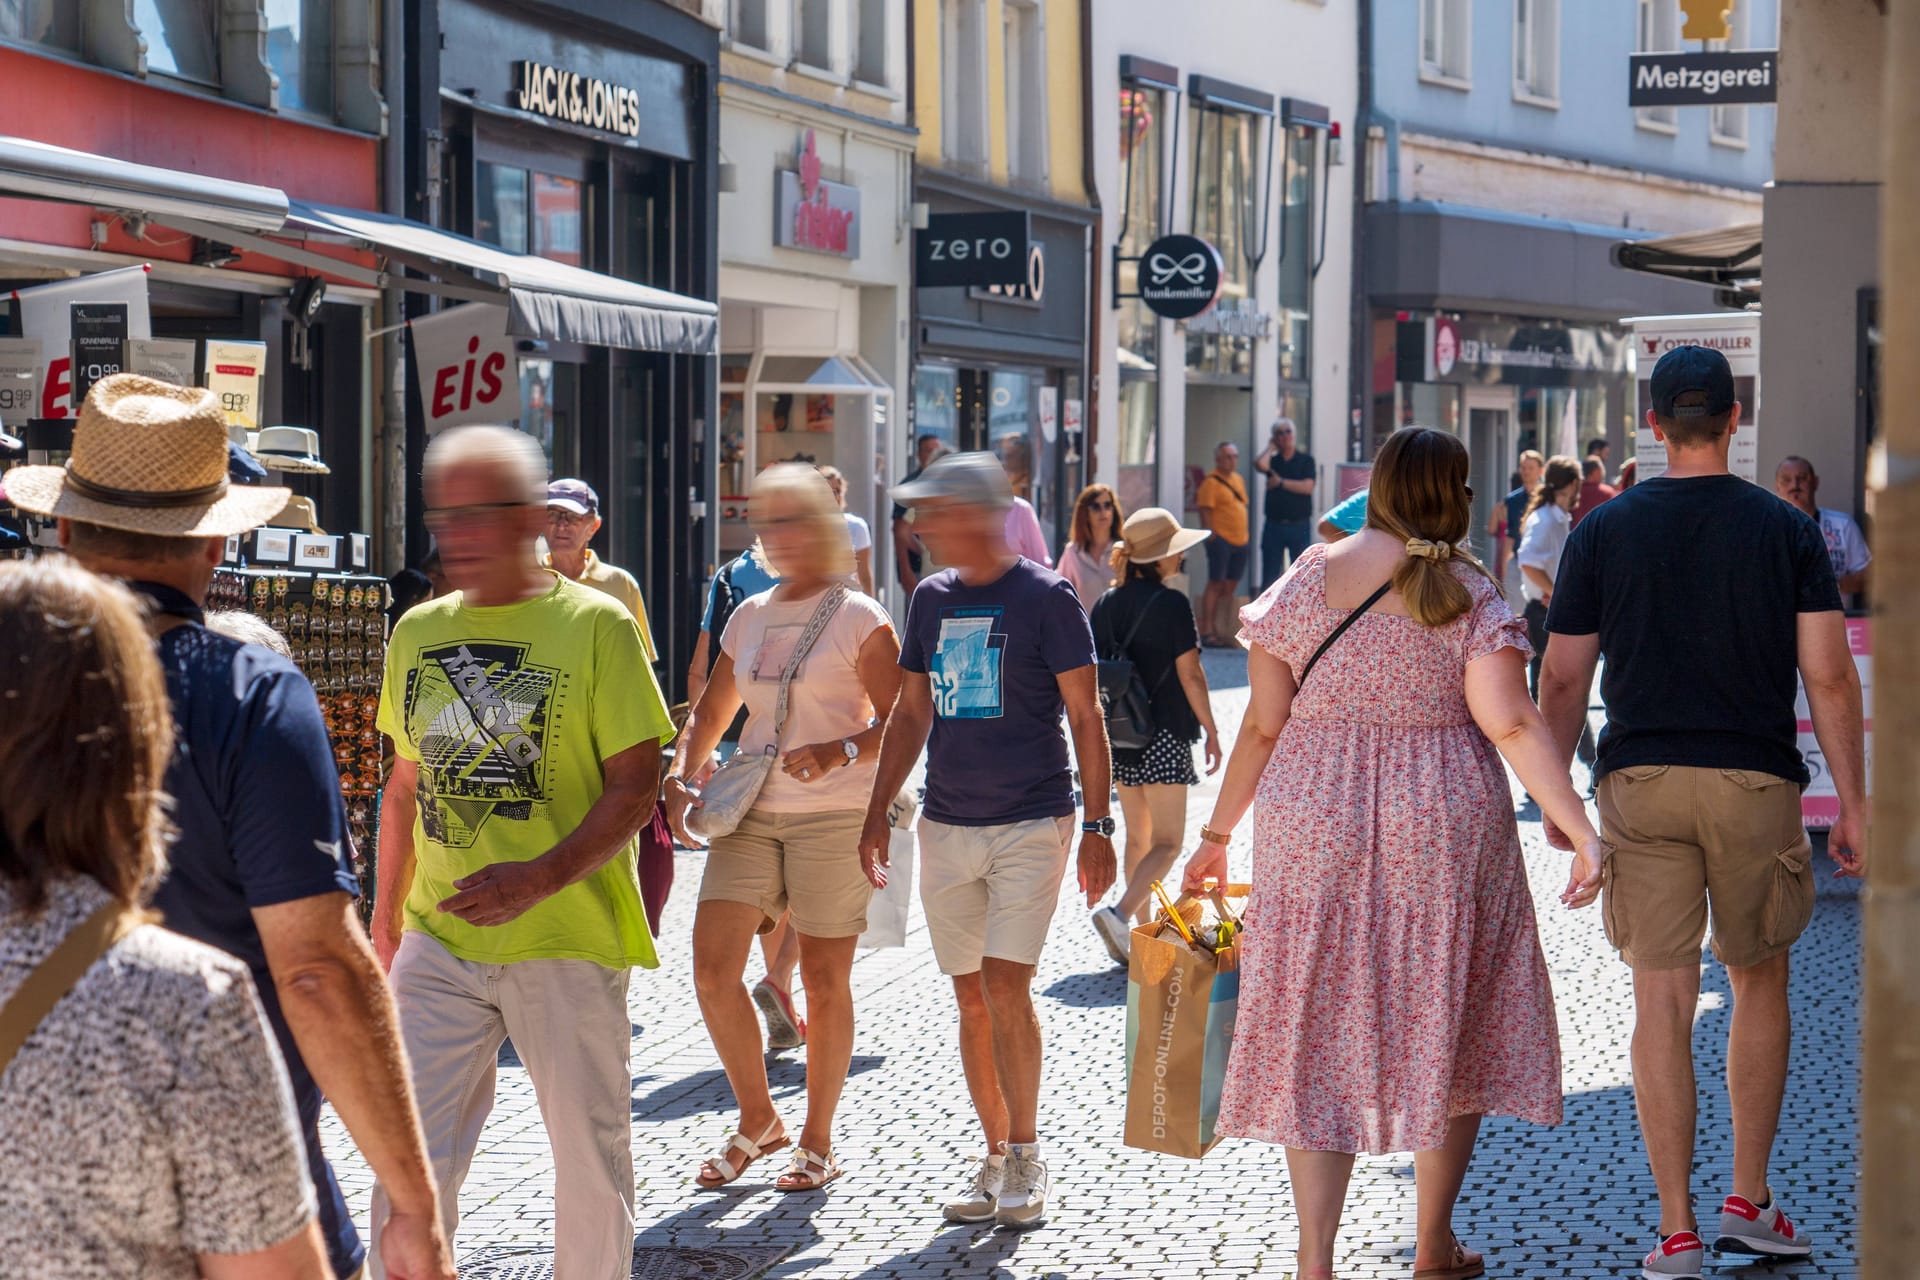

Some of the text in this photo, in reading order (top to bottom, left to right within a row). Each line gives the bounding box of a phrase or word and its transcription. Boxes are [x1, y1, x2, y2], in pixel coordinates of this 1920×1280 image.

[520, 60, 639, 137] JACK&JONES
[1636, 61, 1770, 94] Metzgerei
[930, 238, 1011, 260] zero
[446, 644, 543, 768] TOKYO
[1153, 966, 1185, 1140] DEPOT-ONLINE.COM
